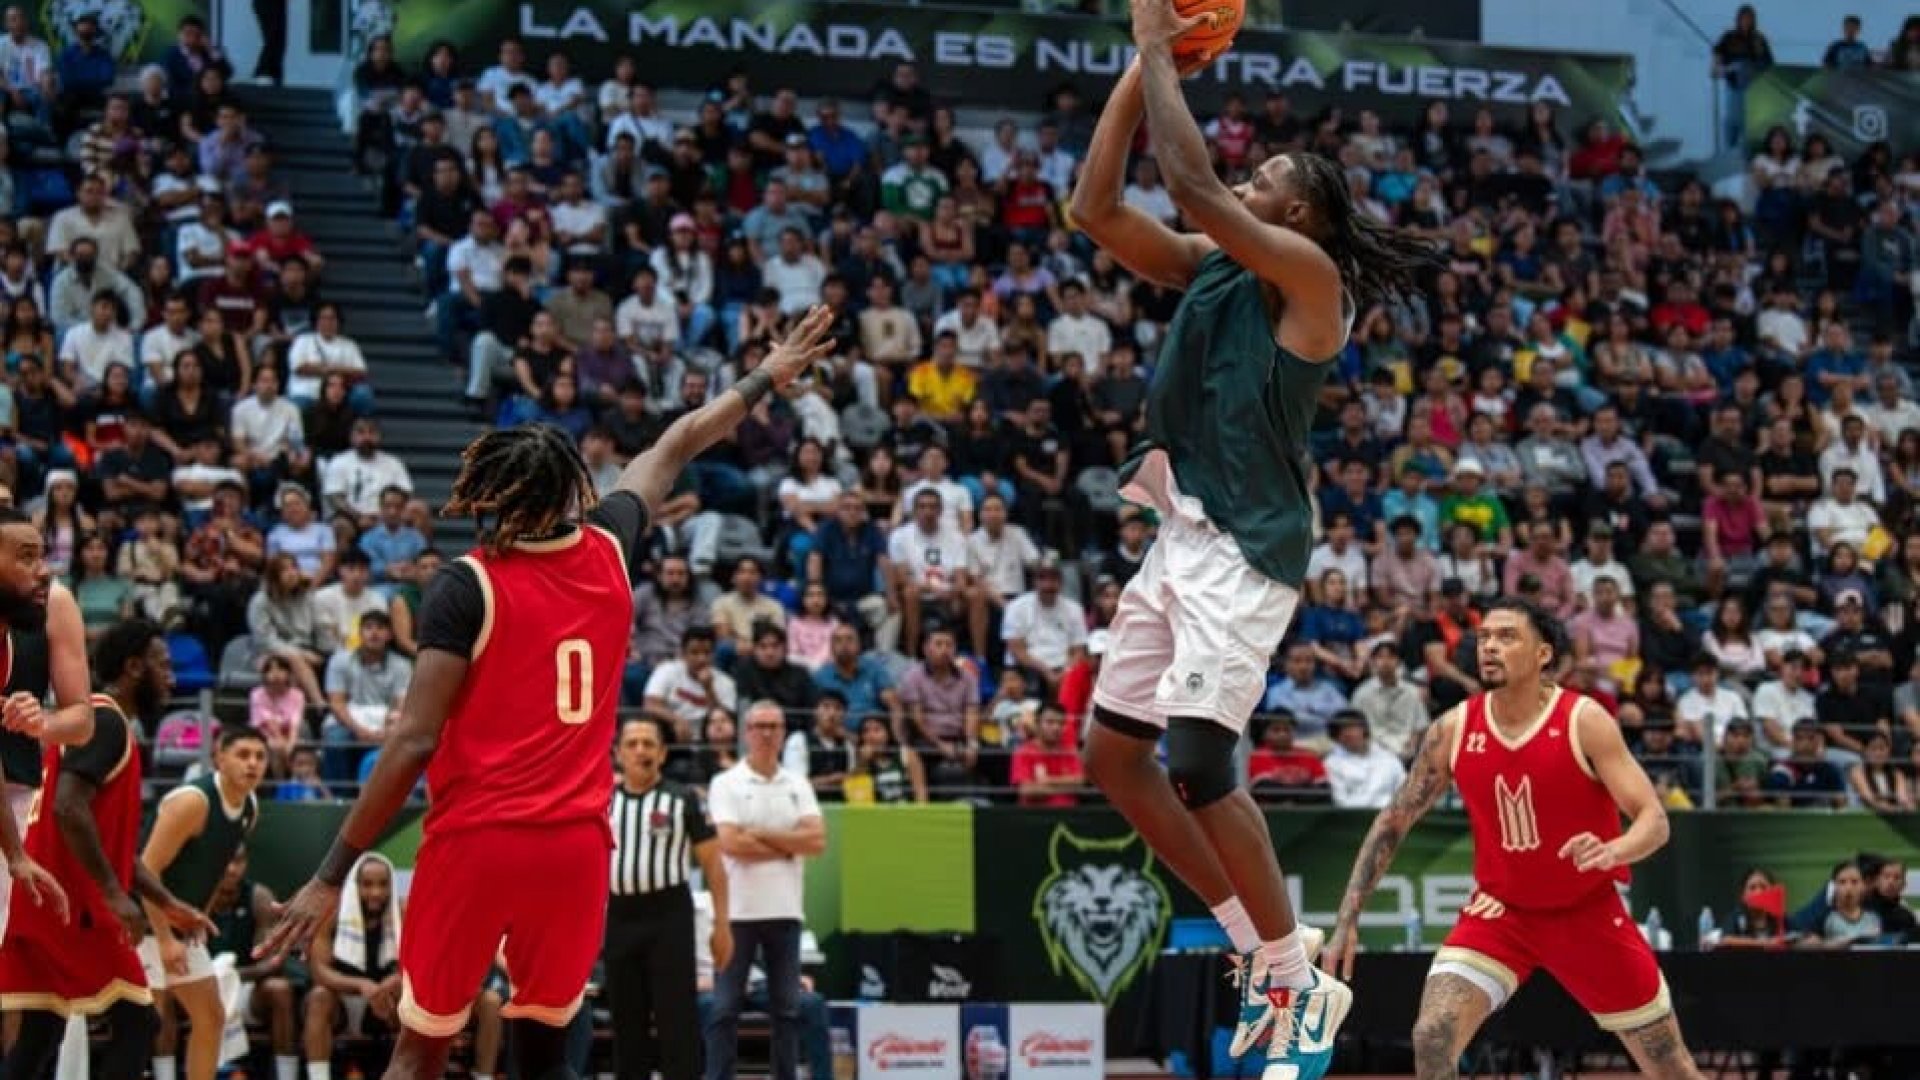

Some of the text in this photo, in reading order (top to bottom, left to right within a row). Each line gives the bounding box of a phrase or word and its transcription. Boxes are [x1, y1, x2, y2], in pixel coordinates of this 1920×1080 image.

[520, 3, 1572, 107] LA MANADA ES NUTRA FUERZA
[556, 638, 593, 724] 0
[1466, 732, 1487, 753] 22
